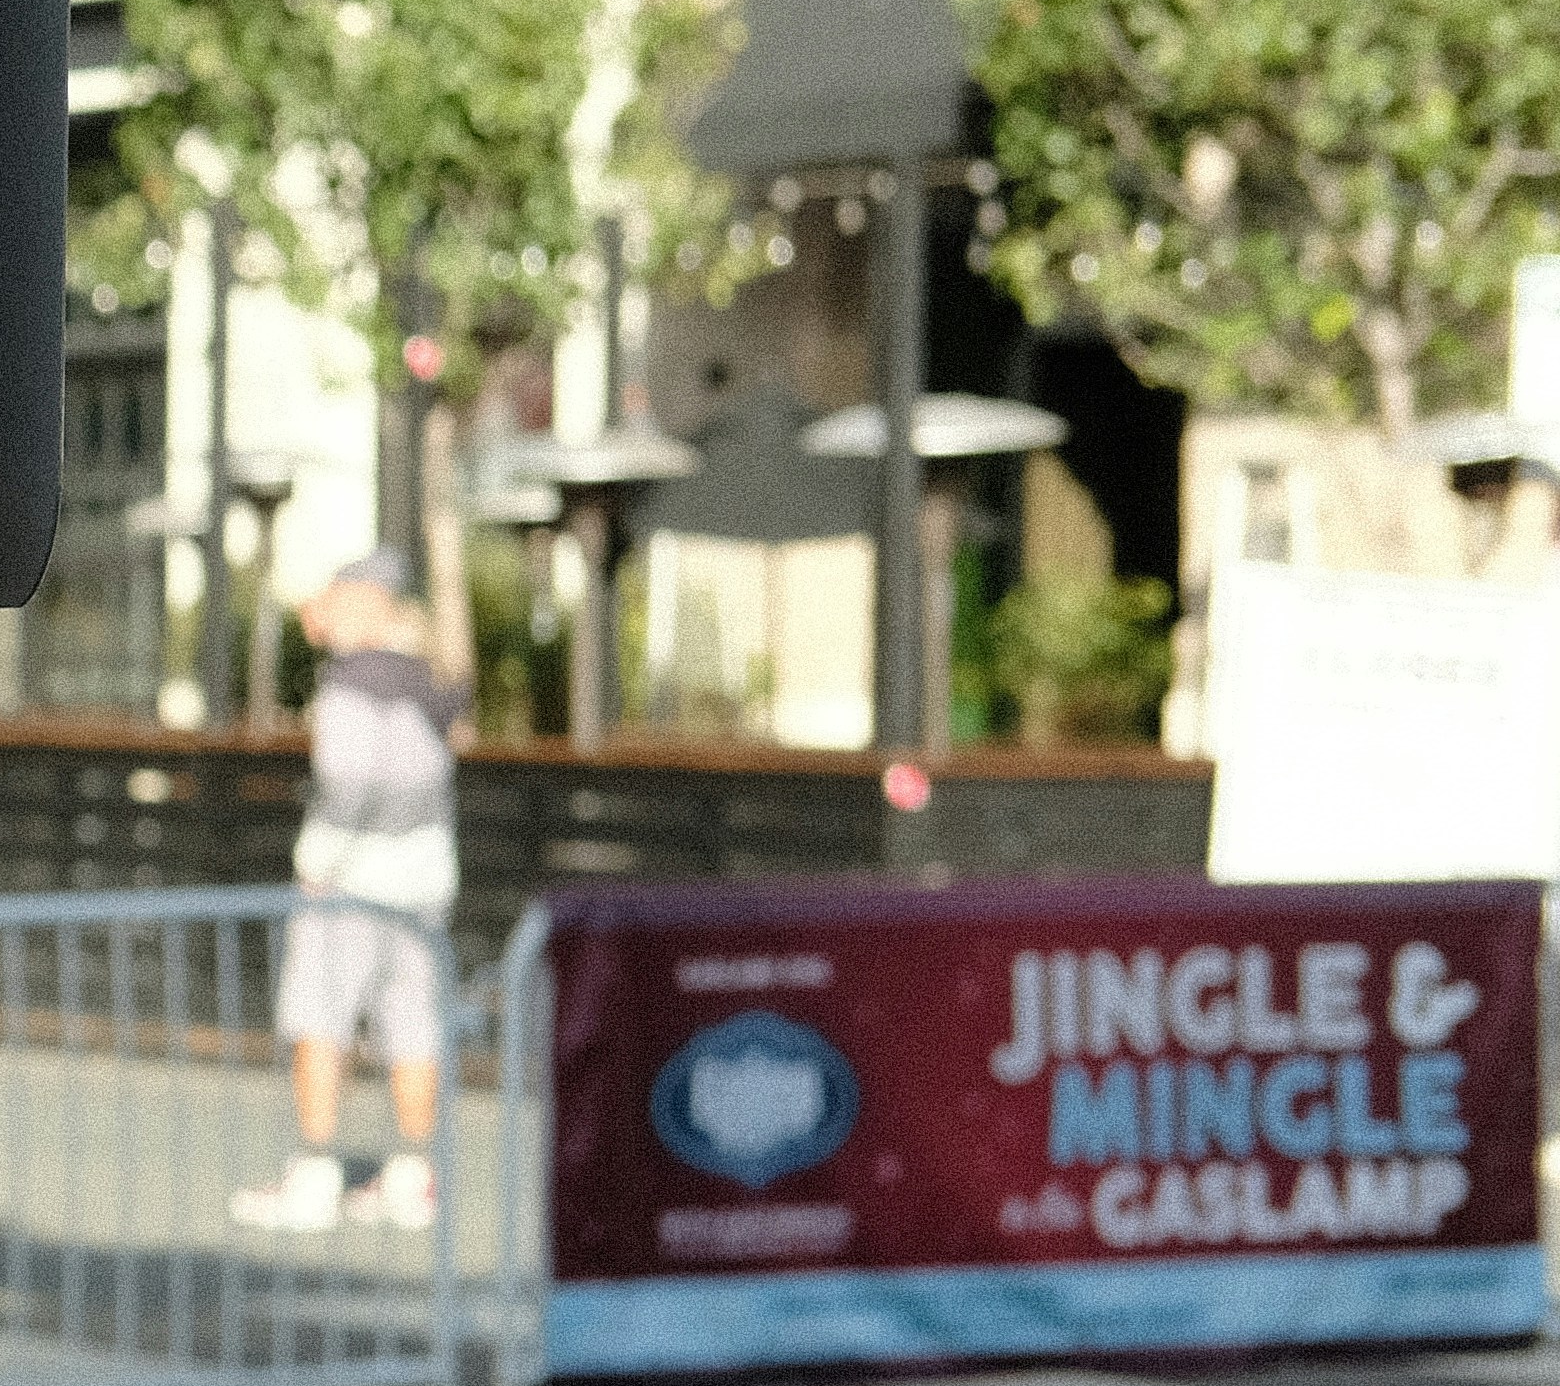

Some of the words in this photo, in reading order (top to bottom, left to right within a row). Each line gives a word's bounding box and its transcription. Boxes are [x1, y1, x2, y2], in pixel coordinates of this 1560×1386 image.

[988, 943, 1373, 1086] JINGLE
[1390, 940, 1481, 1049] &
[1048, 1049, 1472, 1168] MINGLE
[1089, 1154, 1472, 1249] GASLAMP
